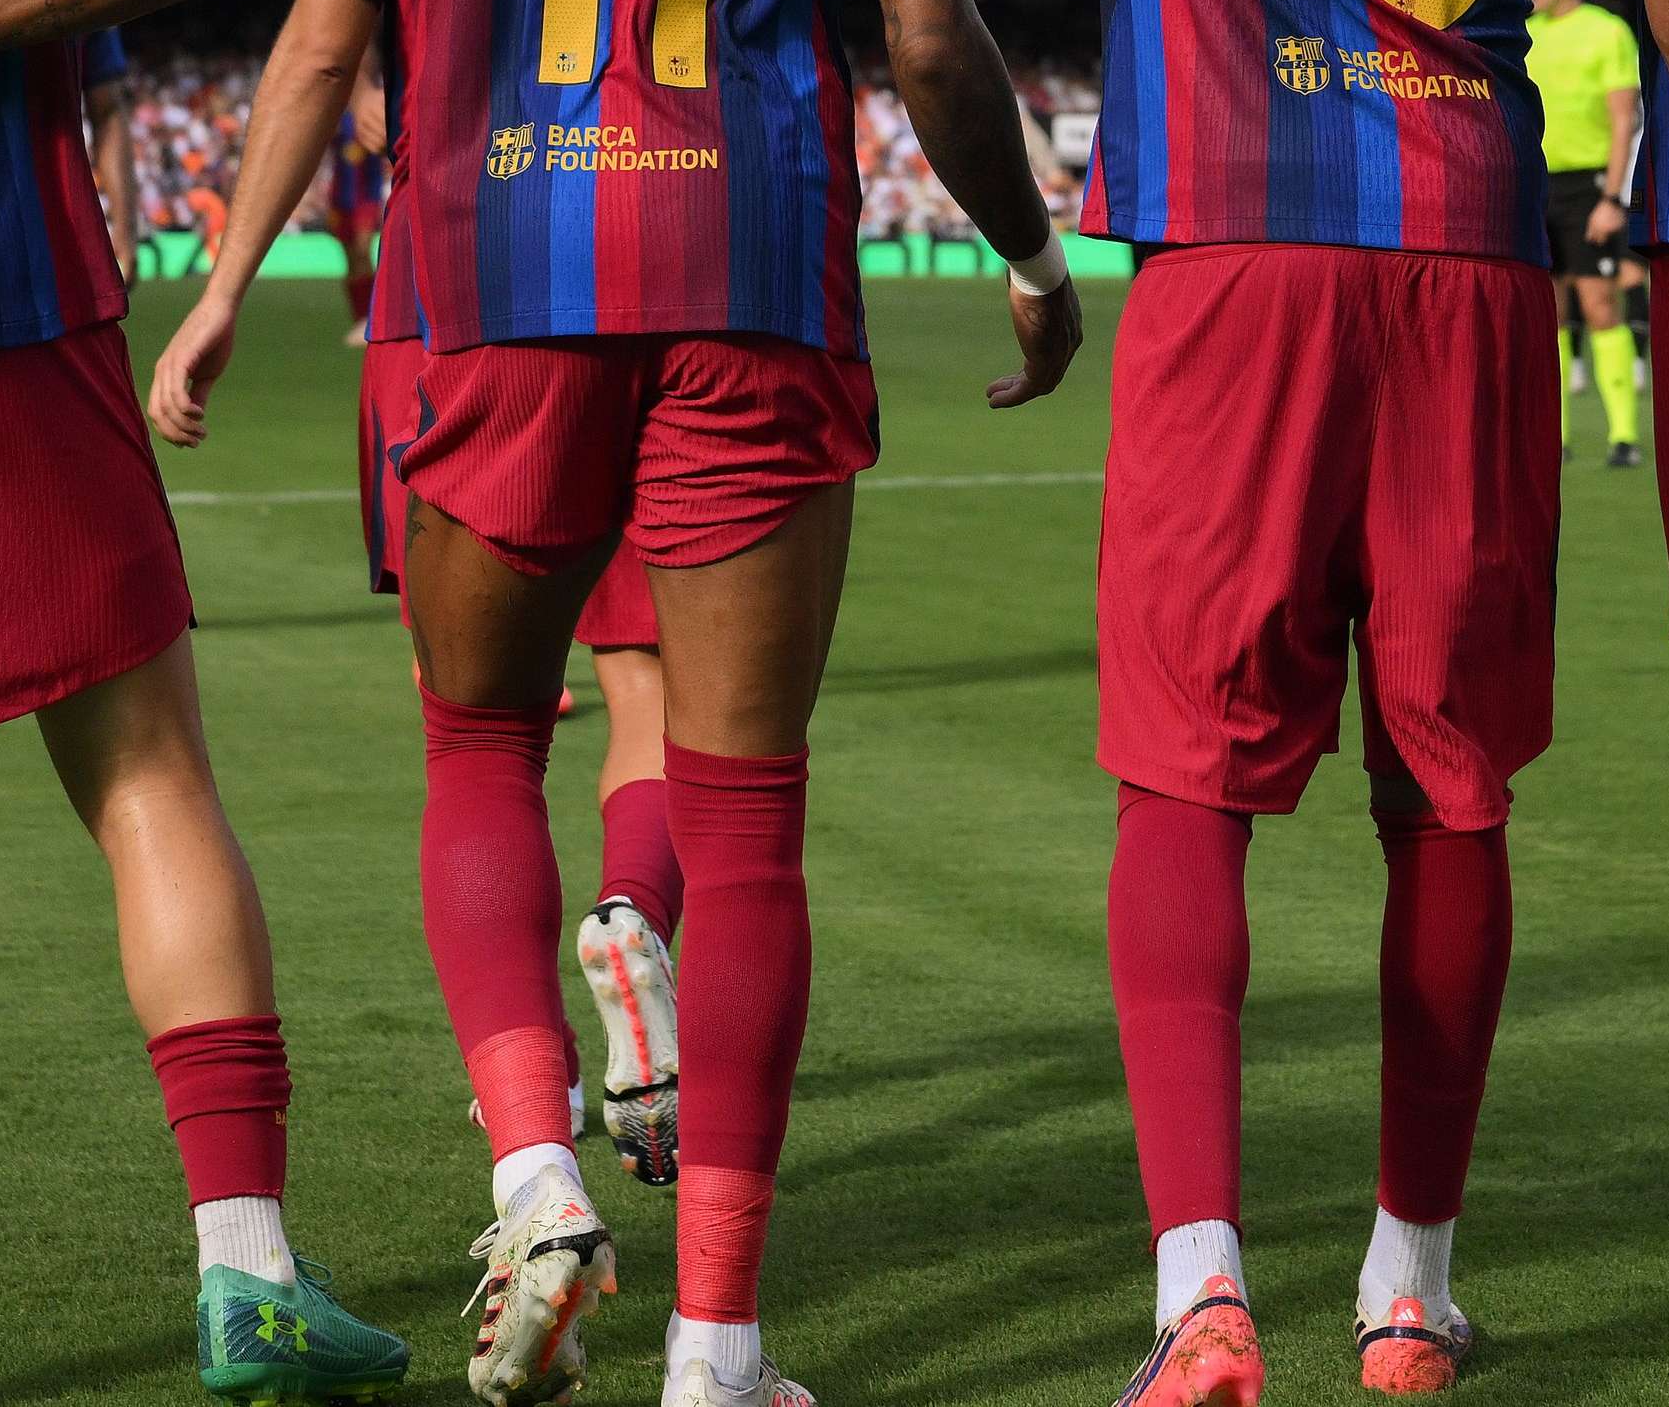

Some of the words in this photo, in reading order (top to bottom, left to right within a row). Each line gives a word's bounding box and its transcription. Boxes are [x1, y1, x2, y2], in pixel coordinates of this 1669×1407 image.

[1336, 47, 1420, 78] BARÇA
[1342, 67, 1491, 100] FOUNDATION
[547, 124, 637, 150] BARÇA
[545, 148, 718, 171] FOUNDATION
